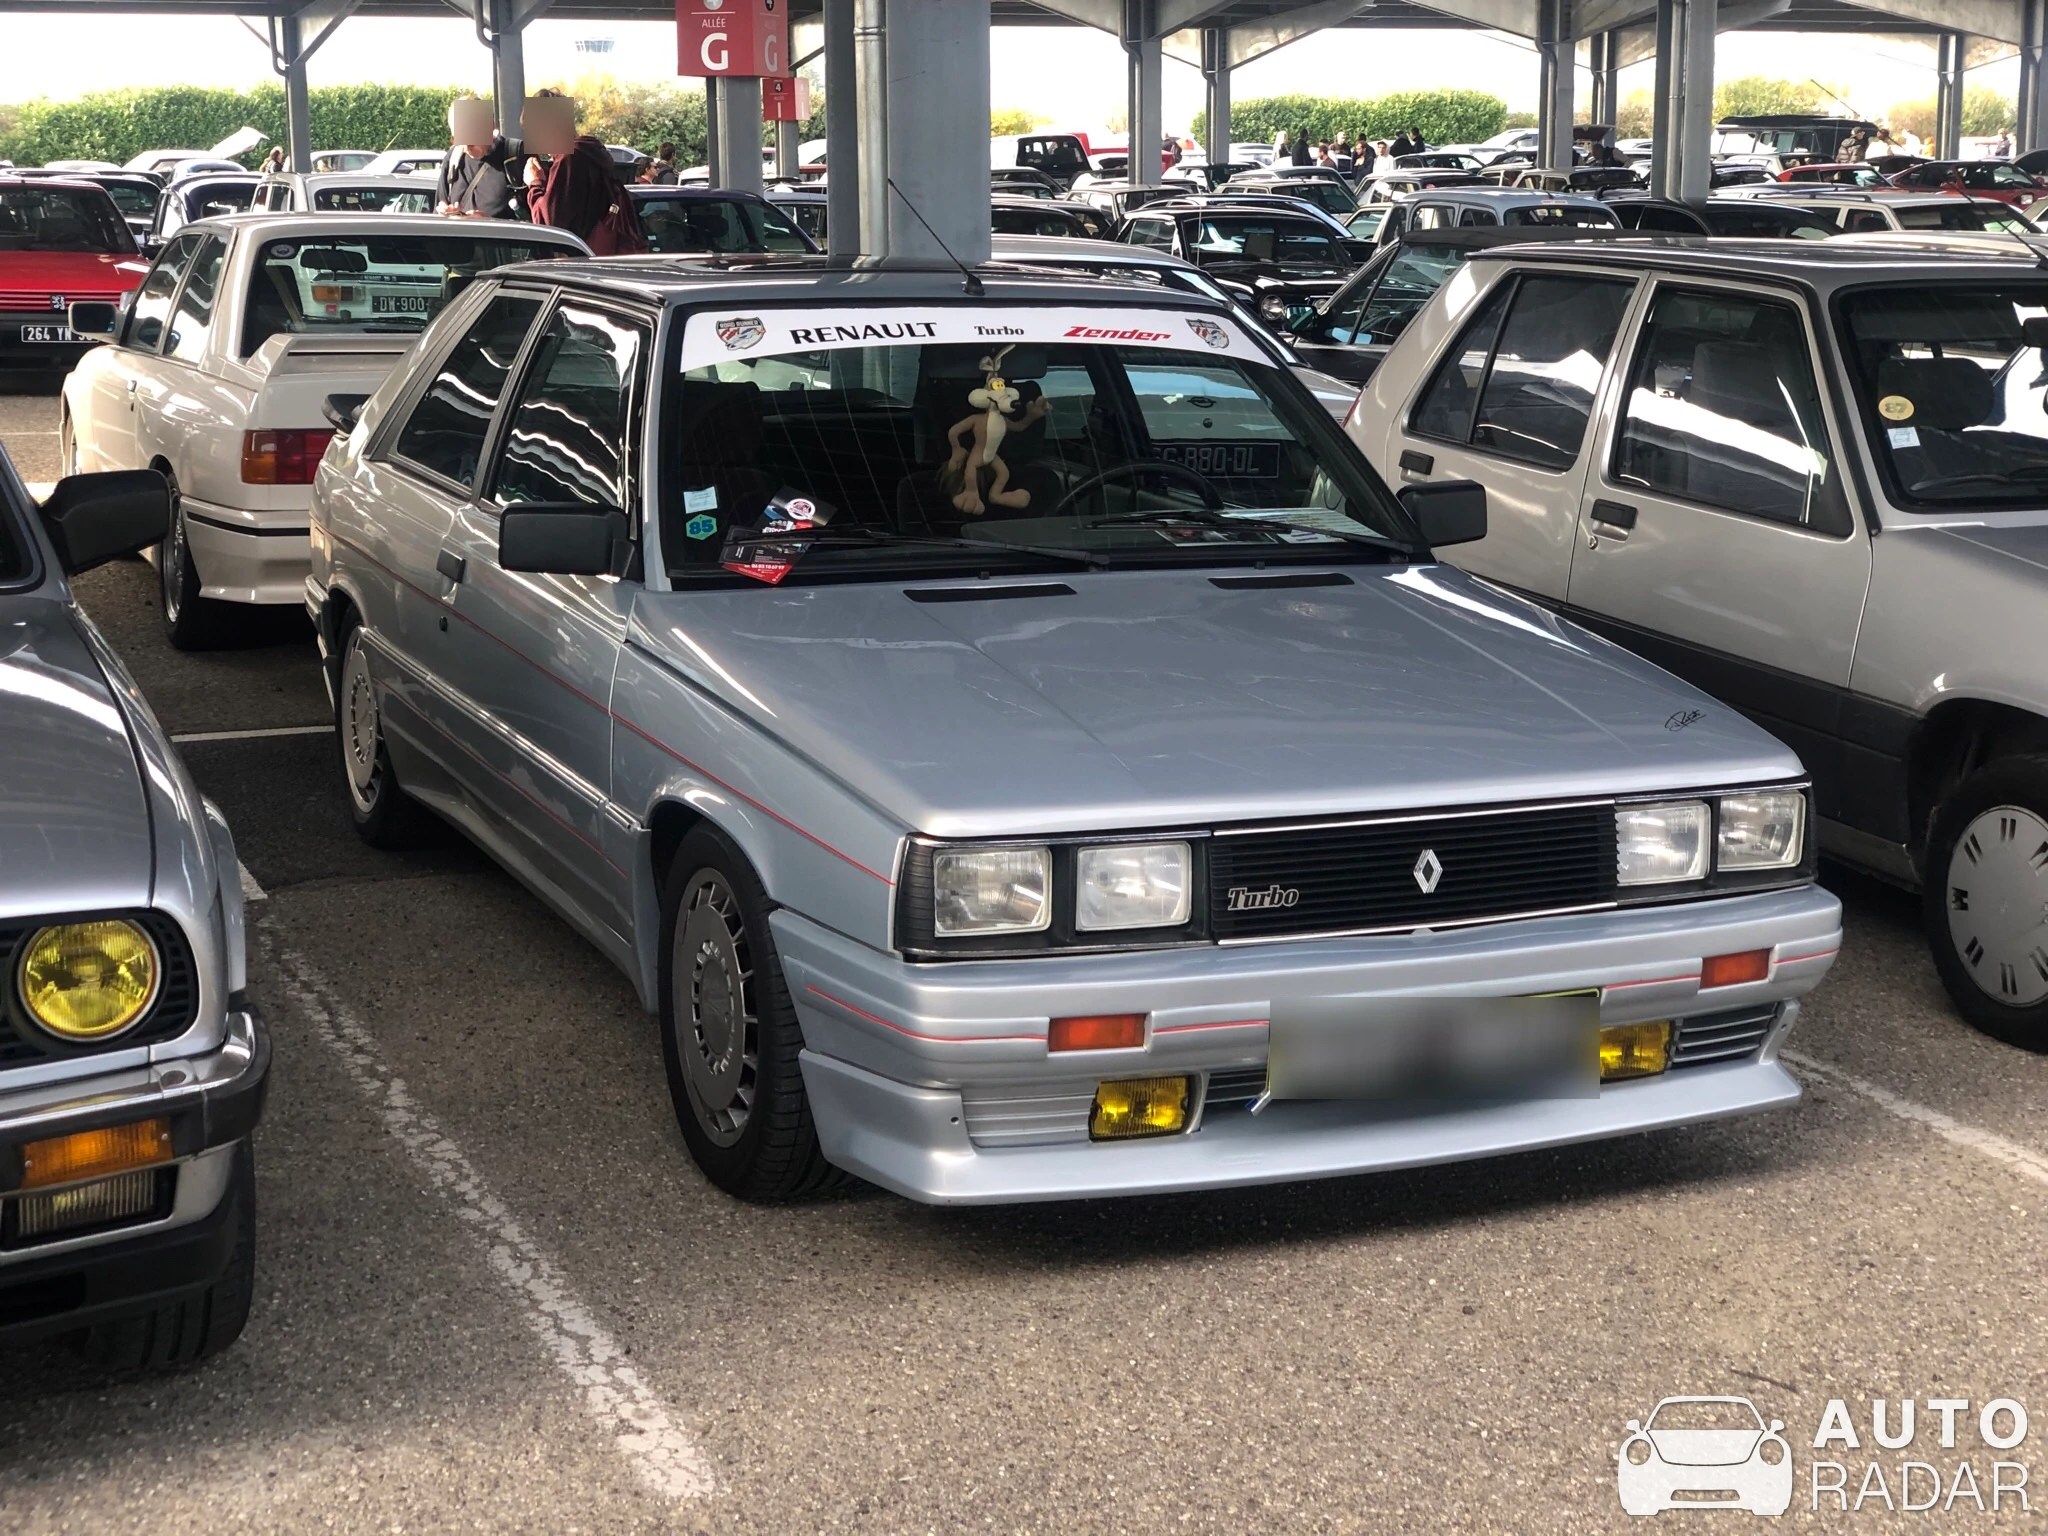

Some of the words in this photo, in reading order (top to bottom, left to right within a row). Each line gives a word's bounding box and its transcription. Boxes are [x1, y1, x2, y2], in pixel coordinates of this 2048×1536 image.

[702, 17, 726, 28] ALLÉE
[701, 32, 729, 71] G
[764, 34, 778, 72] G
[775, 83, 782, 92] 4
[27, 327, 51, 341] 264
[789, 322, 937, 344] RENAULT
[974, 325, 1025, 336] Turbo
[1063, 326, 1172, 342] Zender
[689, 519, 714, 535] 85
[1227, 885, 1299, 910] Turbo
